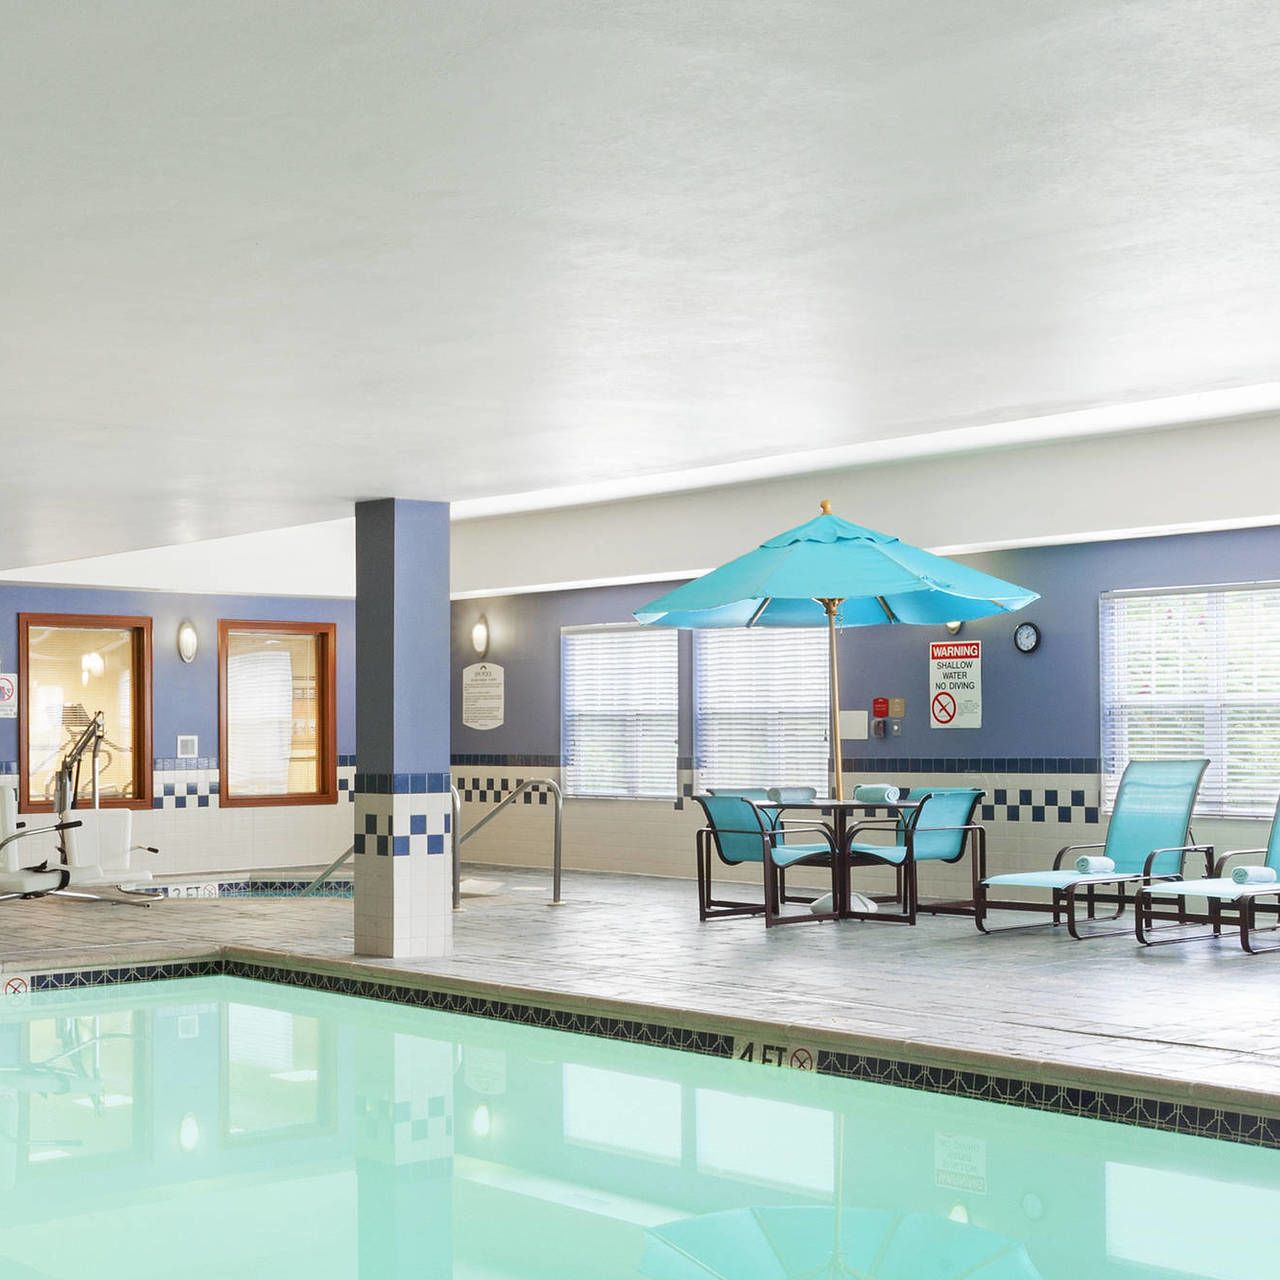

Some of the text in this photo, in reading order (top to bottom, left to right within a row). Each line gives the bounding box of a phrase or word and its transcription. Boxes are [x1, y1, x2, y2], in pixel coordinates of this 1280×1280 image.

[932, 645, 978, 657] WARNING
[936, 660, 973, 670] SHALLOW
[942, 671, 968, 680] WATER
[935, 681, 975, 690] NO DIVING
